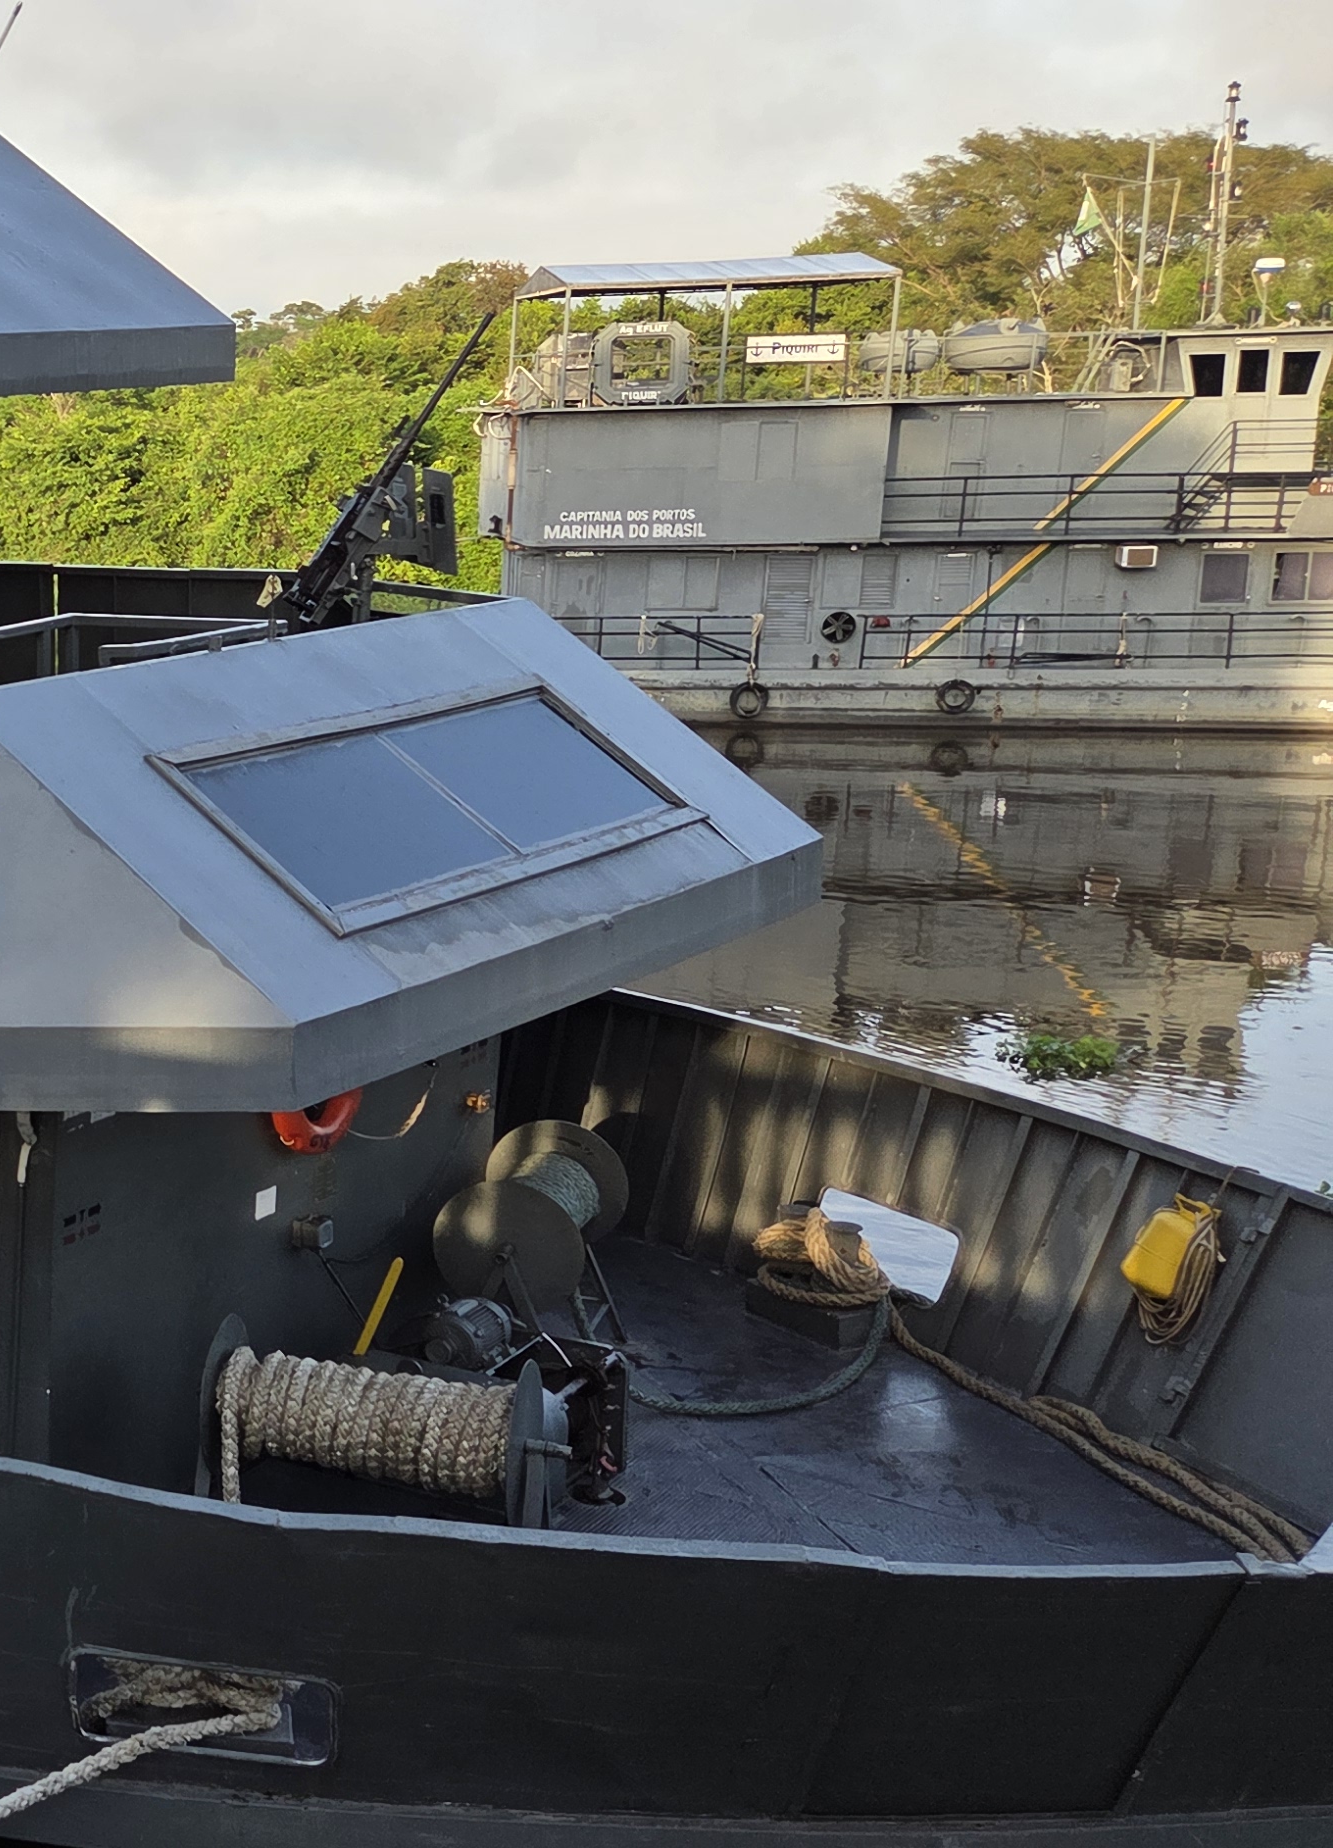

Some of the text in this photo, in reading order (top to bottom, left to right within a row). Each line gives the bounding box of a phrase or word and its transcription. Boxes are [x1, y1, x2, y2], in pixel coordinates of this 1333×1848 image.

[559, 509, 696, 522] CAPITANIA DOS PORTOS
[543, 522, 707, 539] MARINHA DO BRASIL
